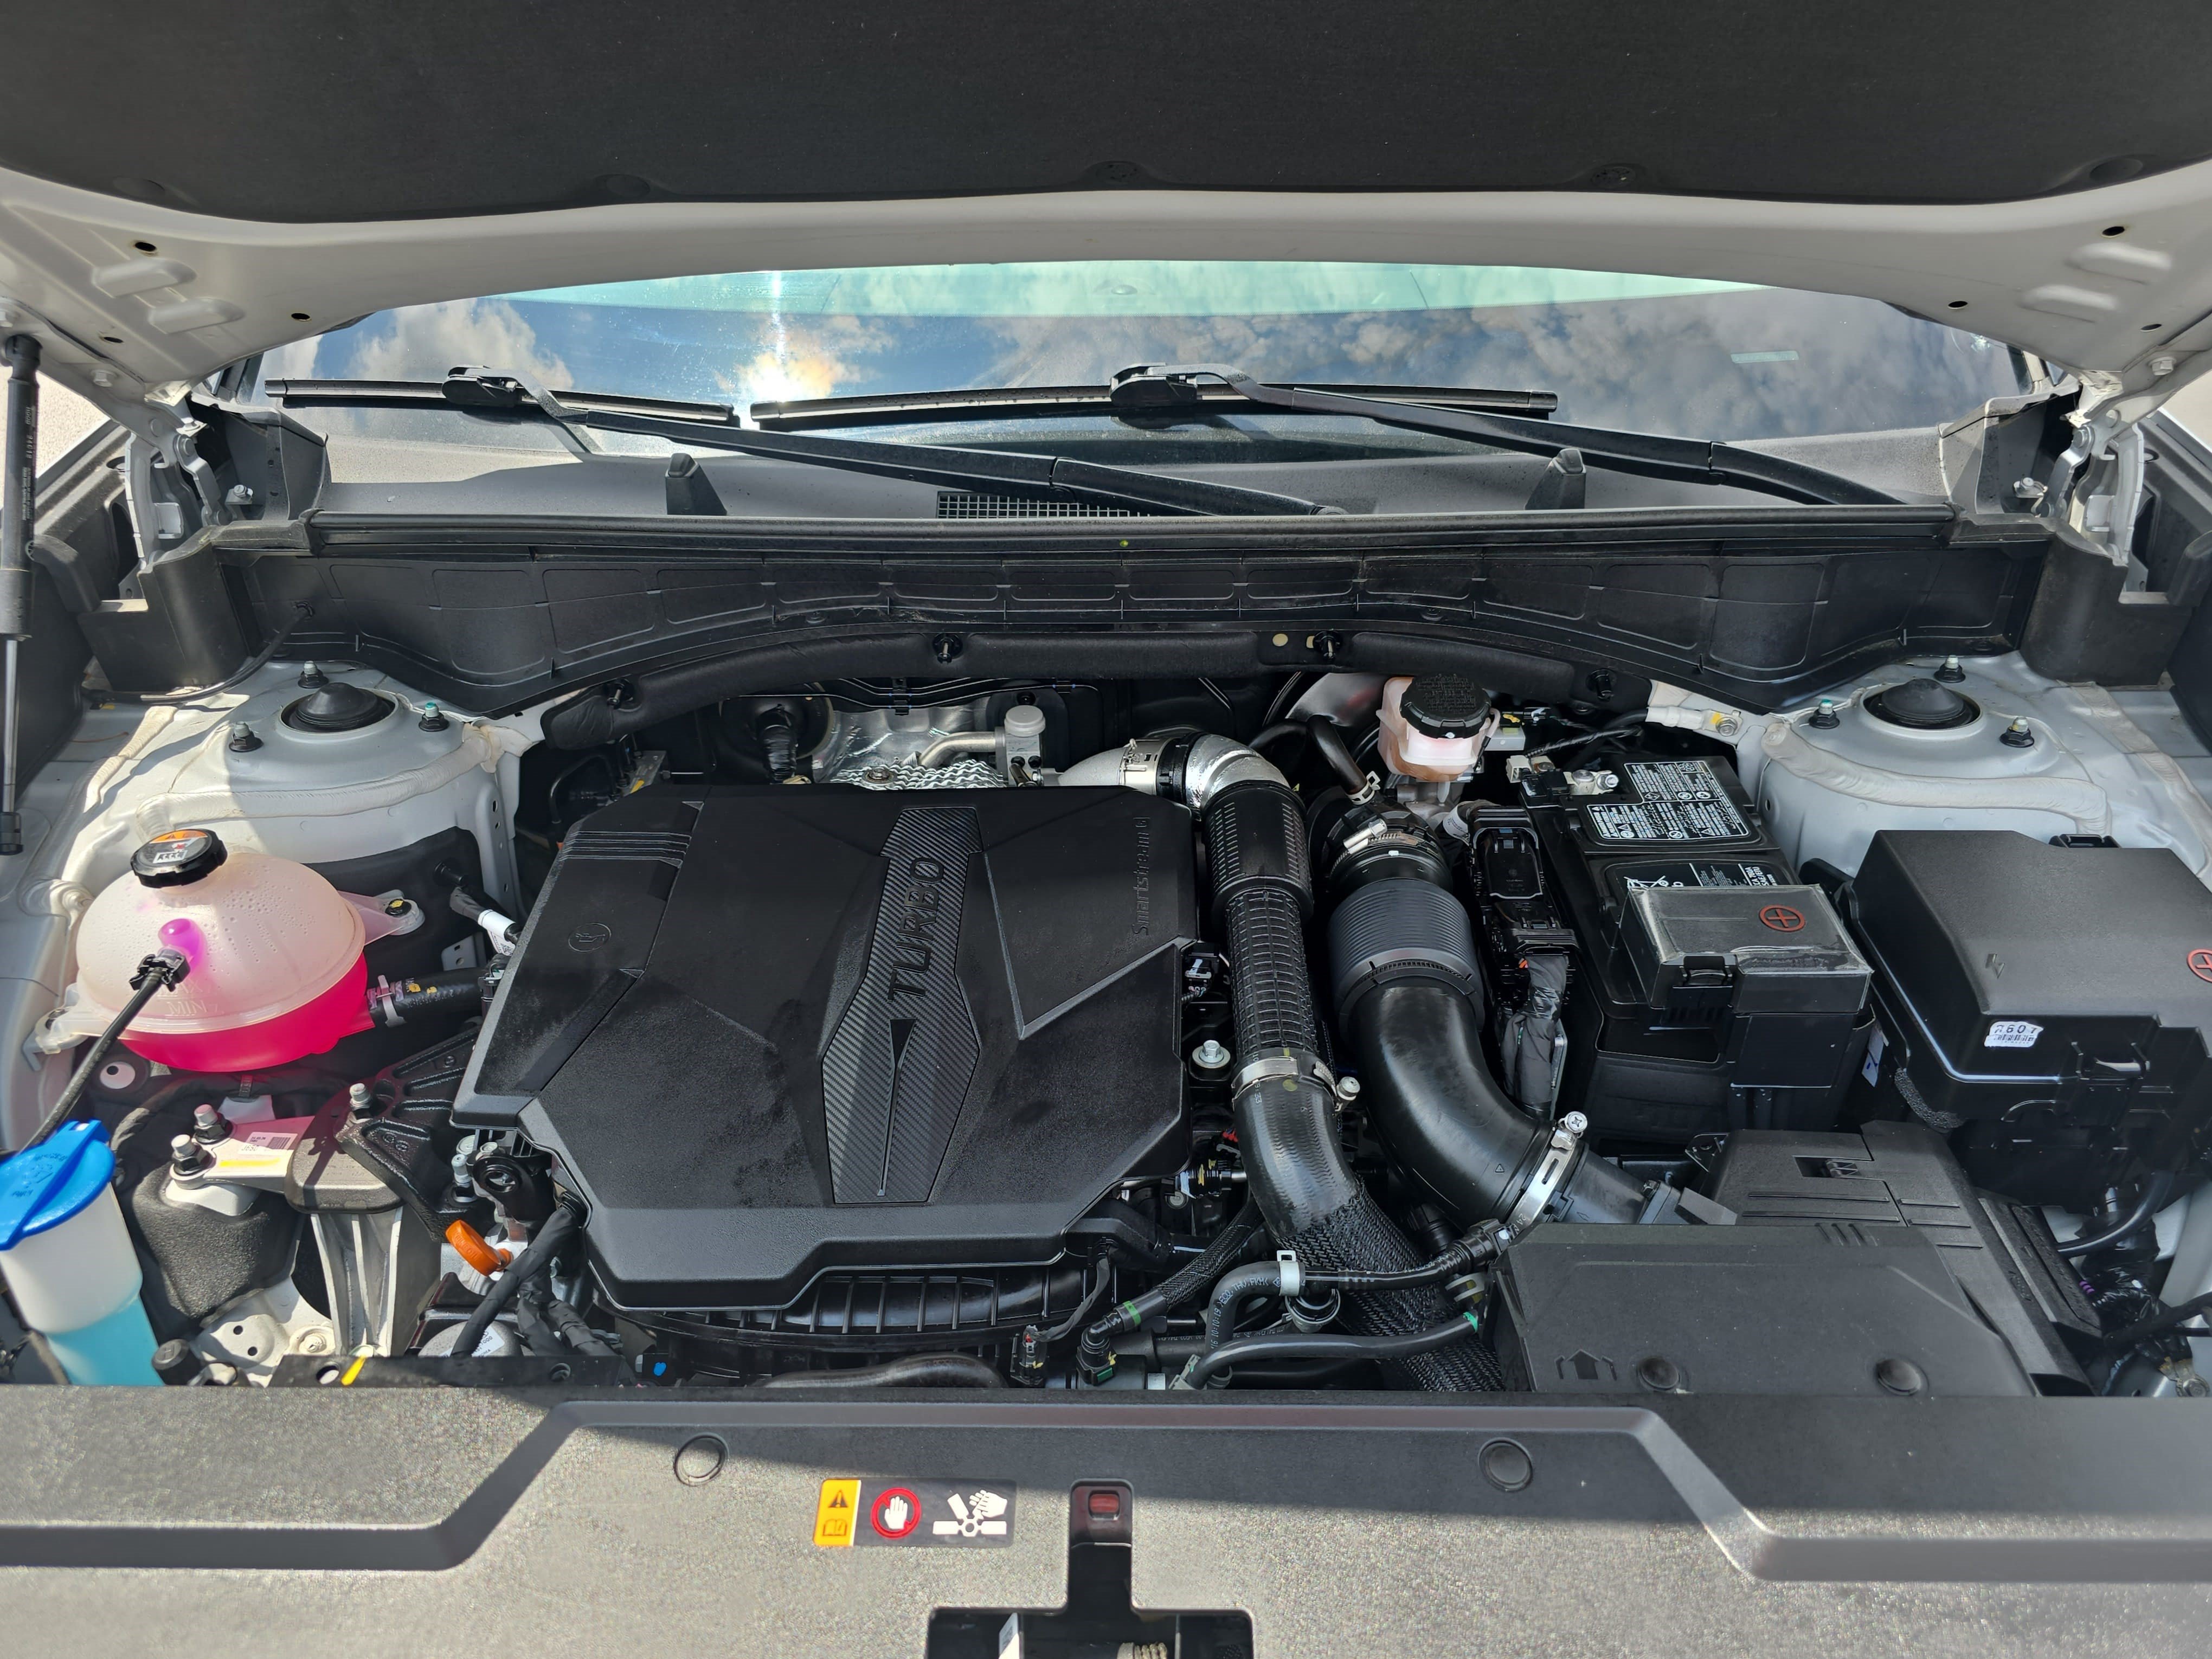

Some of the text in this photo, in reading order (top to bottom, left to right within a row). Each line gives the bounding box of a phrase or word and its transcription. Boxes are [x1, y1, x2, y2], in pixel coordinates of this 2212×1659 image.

[888, 856, 944, 1003] TURBO
[1131, 832, 1150, 936] Smartstream
[166, 999, 208, 1015] MIN
